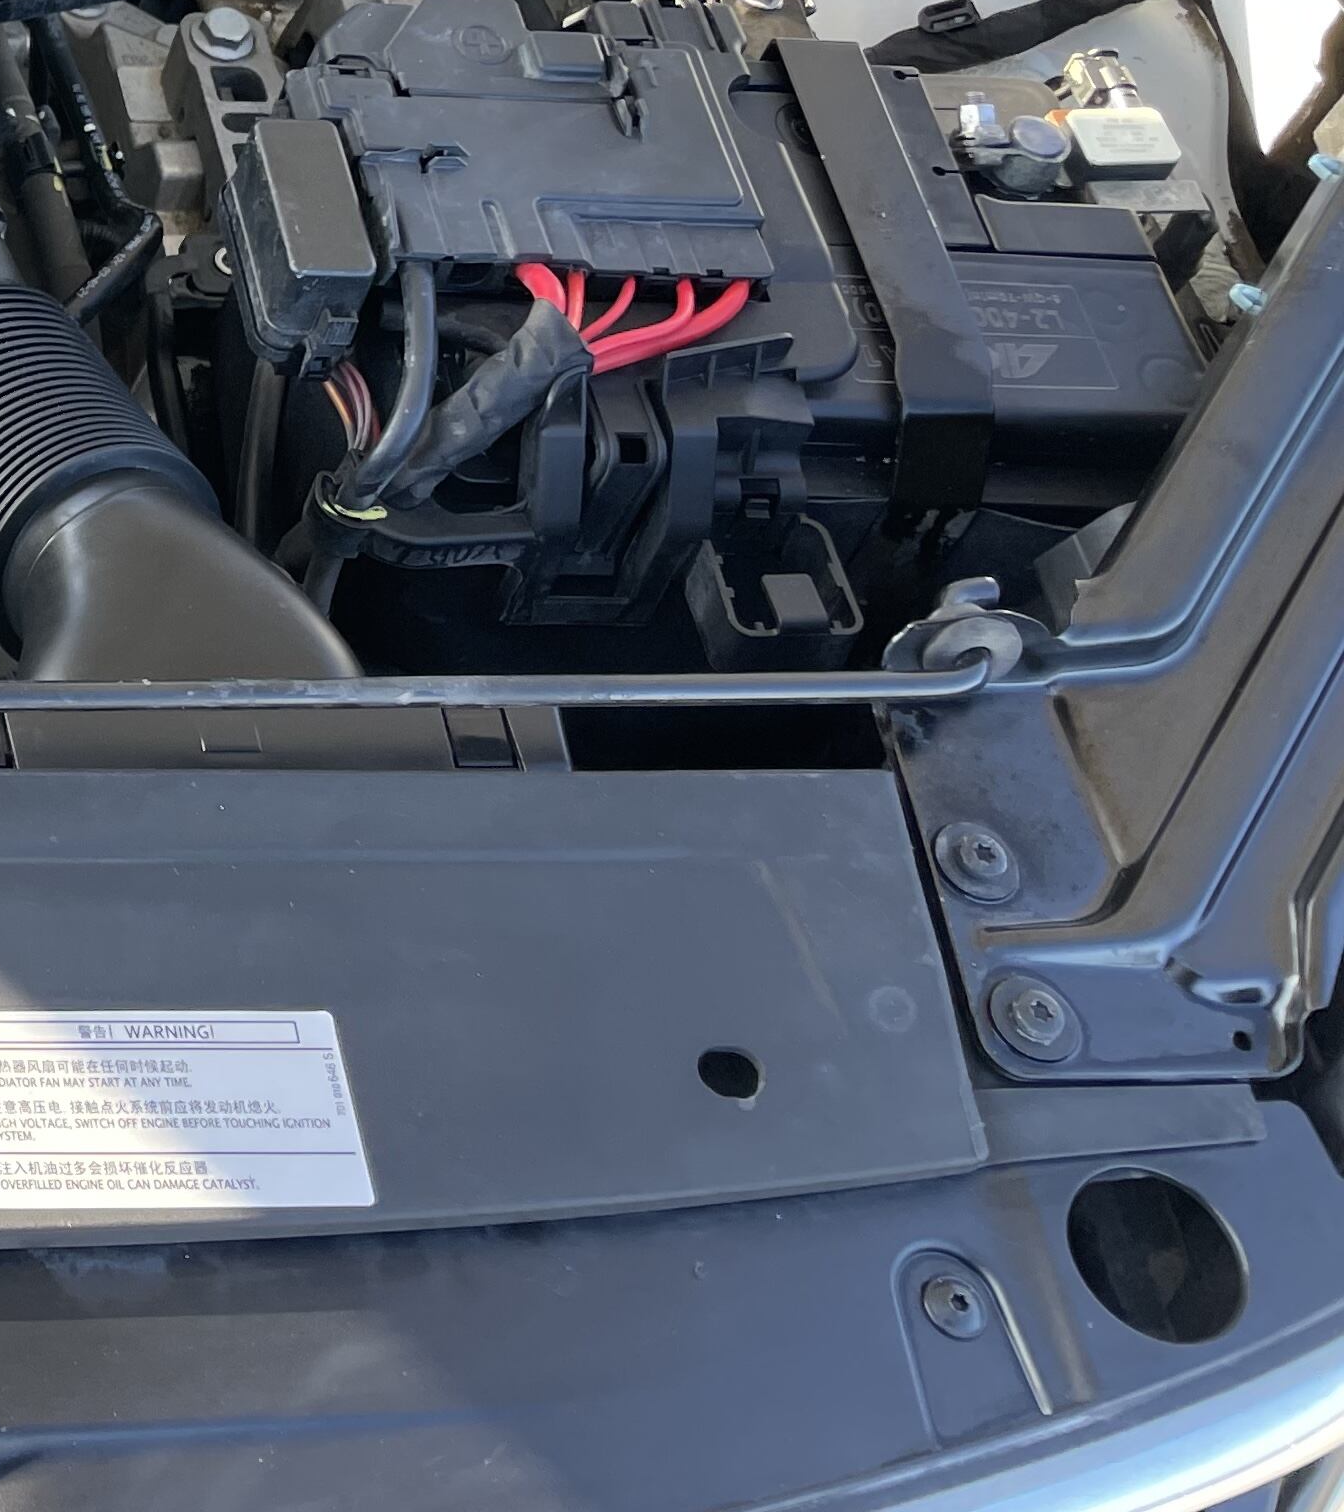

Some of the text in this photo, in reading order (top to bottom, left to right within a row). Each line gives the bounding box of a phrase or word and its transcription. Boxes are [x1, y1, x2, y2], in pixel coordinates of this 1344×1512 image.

[124, 1024, 215, 1040] WARNING!
[39, 1077, 61, 1089] FAN
[63, 1077, 87, 1089] MAY
[88, 1077, 121, 1089] START
[124, 1077, 138, 1089] AT
[140, 1076, 162, 1089] ANY
[164, 1076, 193, 1088] TIME.
[20, 1117, 73, 1130] VOLTAGE,
[75, 1117, 115, 1129] SWITCH
[117, 1117, 139, 1129] OFF
[141, 1117, 180, 1129] ENGINE
[182, 1117, 222, 1129] BEFORE
[223, 1117, 281, 1129] TOUCHING
[283, 1117, 332, 1129] IGNITION
[0, 1178, 63, 1191] OVERFILLED
[65, 1178, 104, 1191] ENGINE
[106, 1178, 125, 1191] OIL
[127, 1178, 151, 1191] CAN
[154, 1178, 201, 1191] DAMAGE
